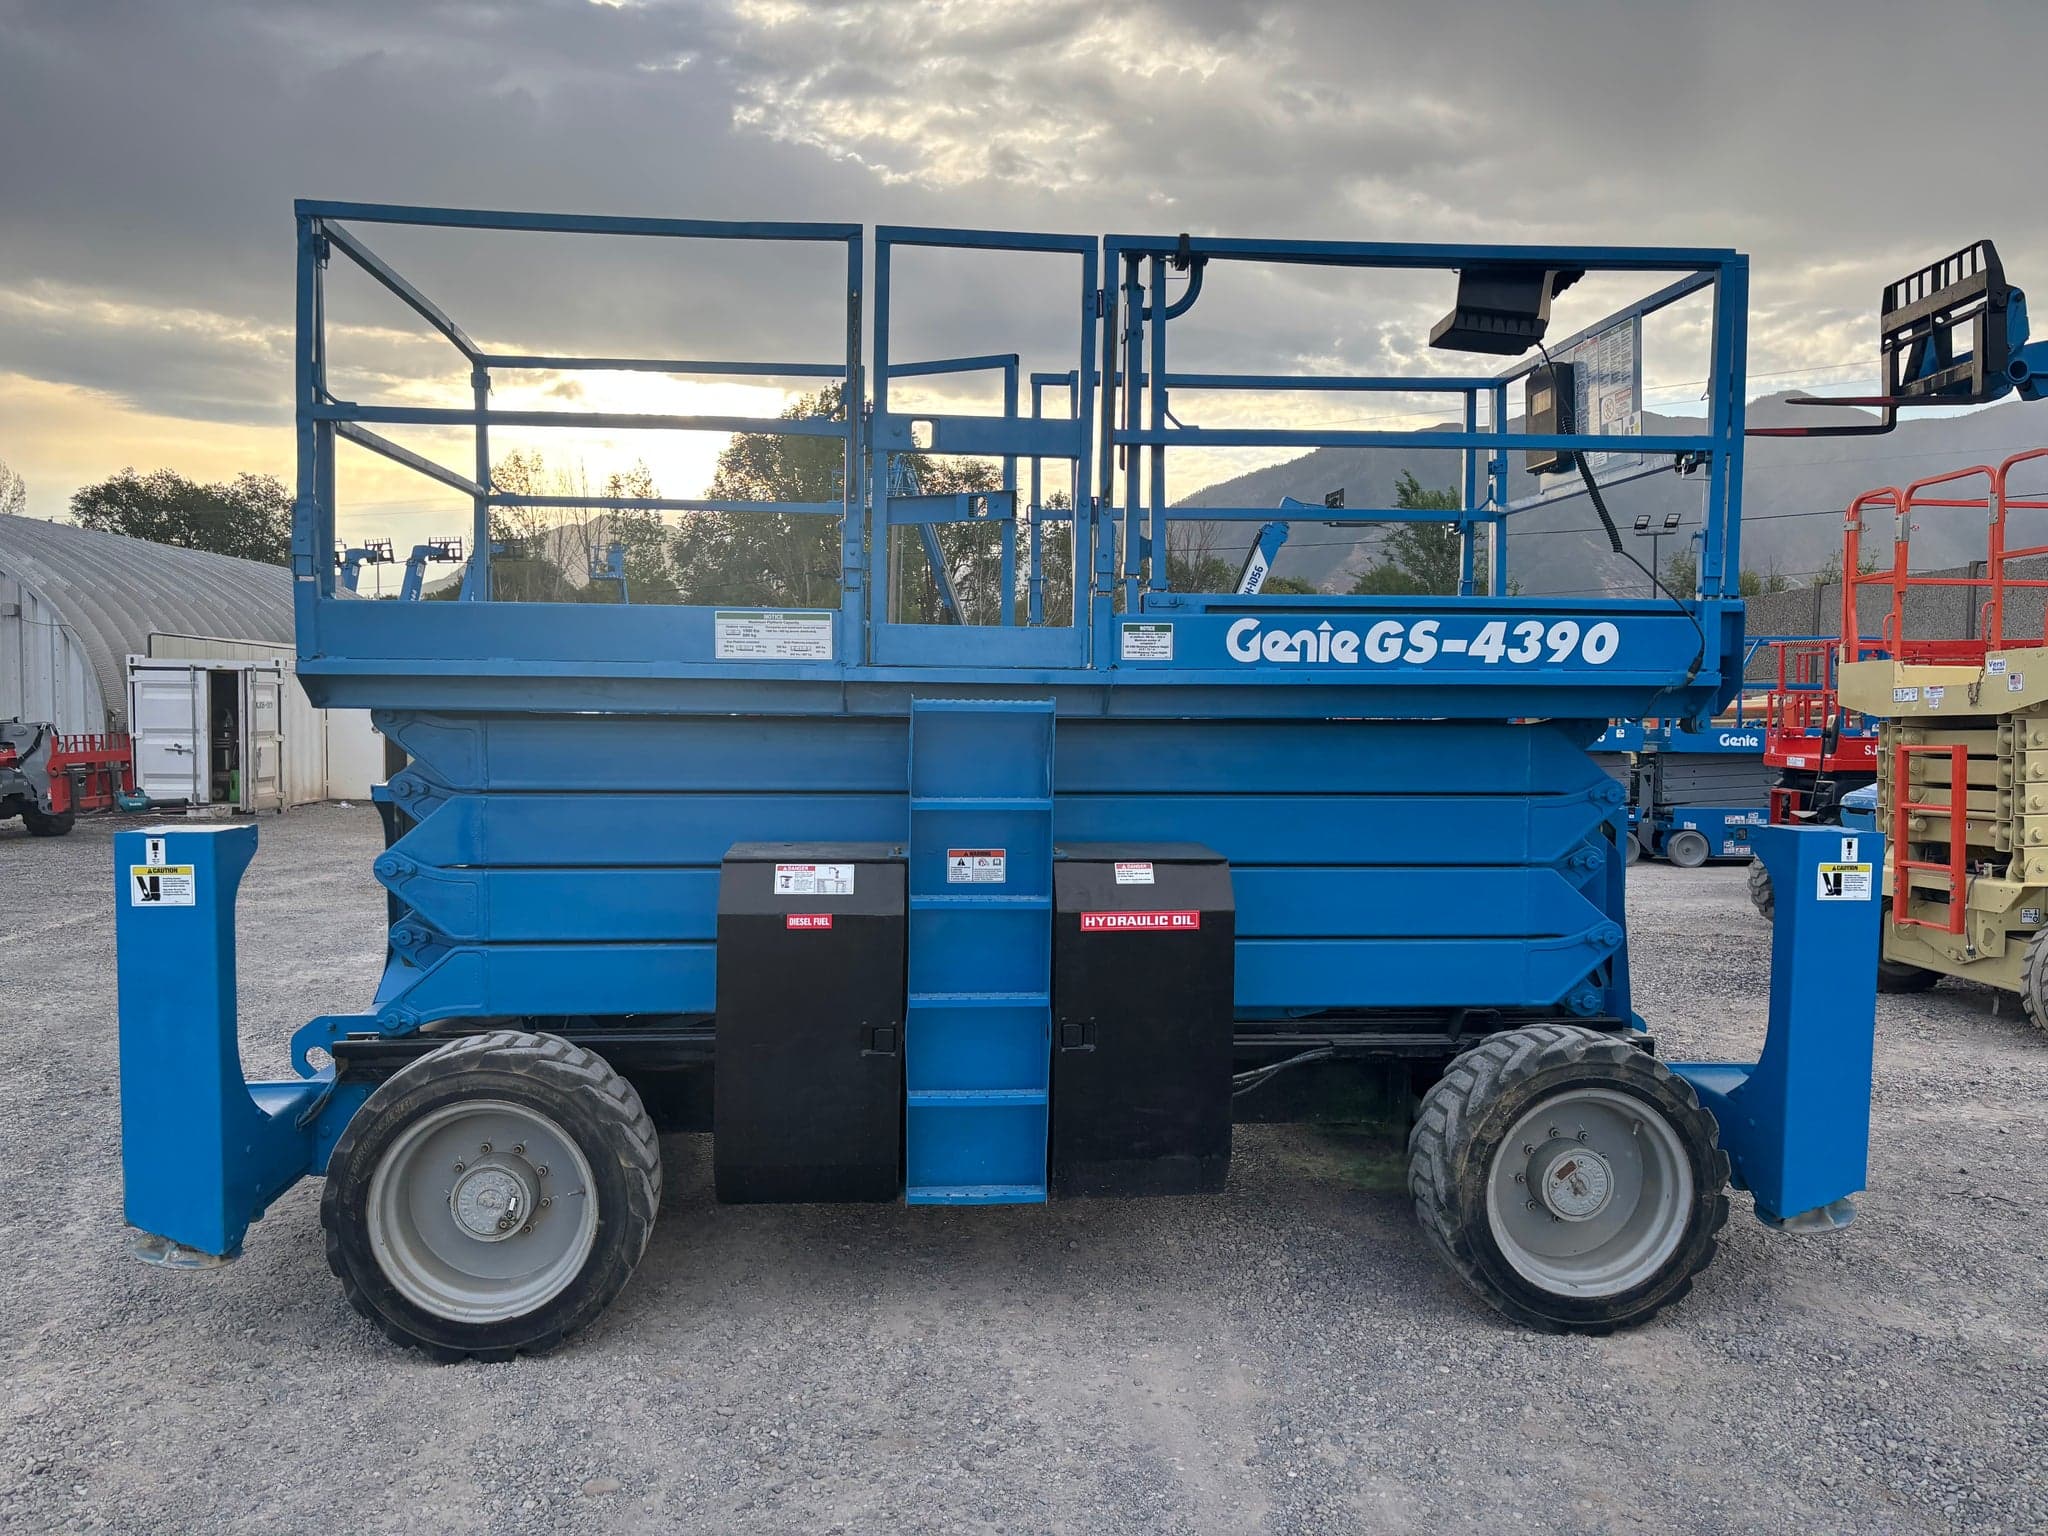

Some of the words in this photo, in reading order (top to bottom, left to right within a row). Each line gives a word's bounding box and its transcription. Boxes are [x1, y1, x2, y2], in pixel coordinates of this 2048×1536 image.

[1225, 618, 1361, 663] Genie
[1364, 619, 1620, 665] GS-4390
[1719, 733, 1759, 747] Genie
[789, 917, 812, 926] DIESEL
[813, 917, 830, 926] FUEL
[1085, 915, 1169, 927] HYDRAULIC
[1172, 915, 1195, 926] OIL
